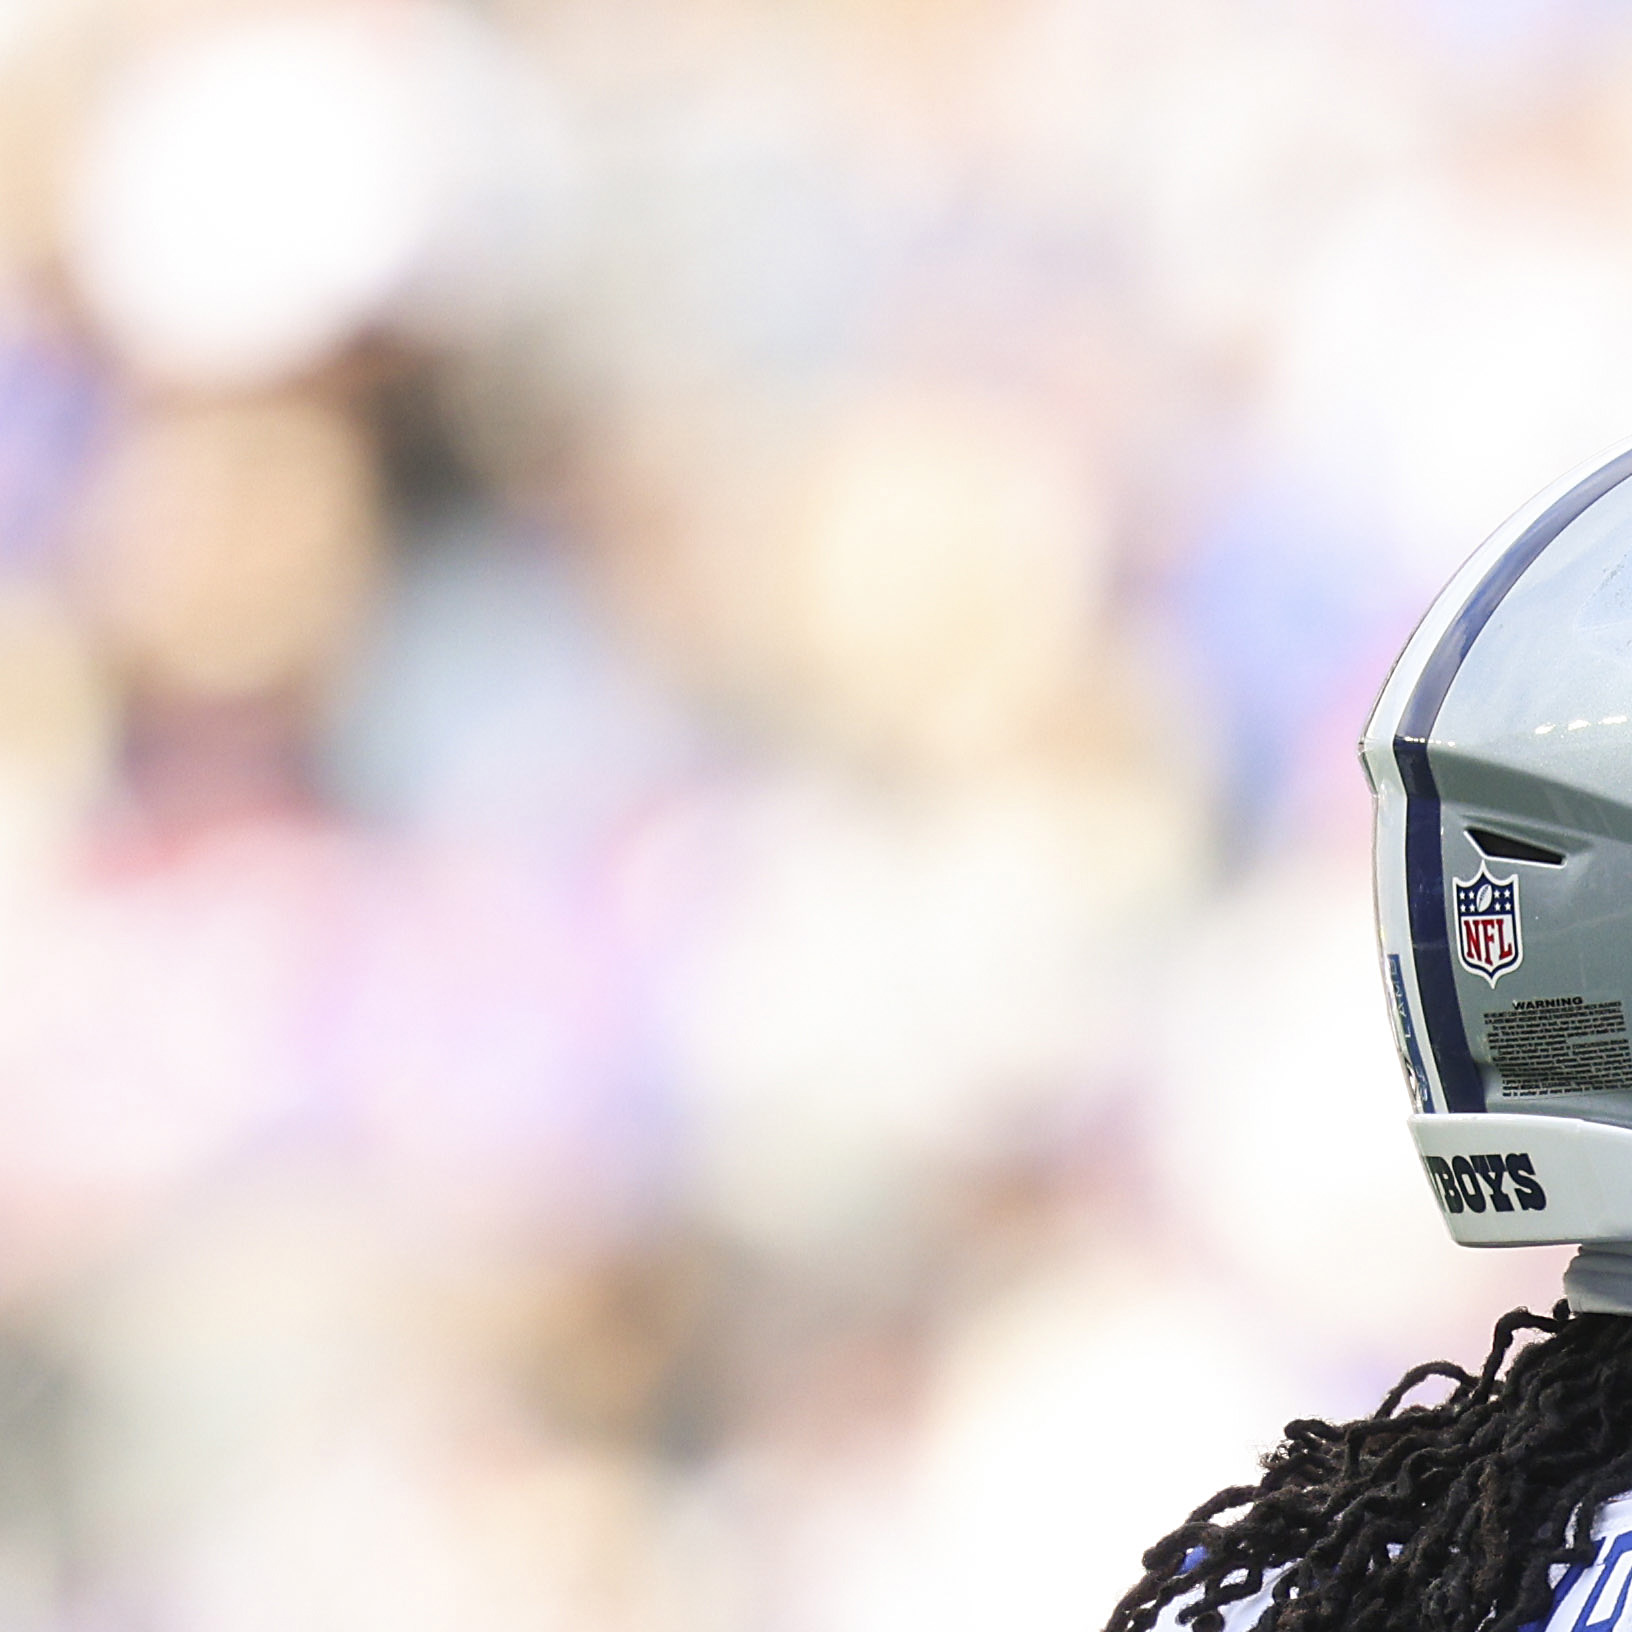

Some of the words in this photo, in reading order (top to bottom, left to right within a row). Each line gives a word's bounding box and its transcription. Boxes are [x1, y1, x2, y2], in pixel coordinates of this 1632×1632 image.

[1463, 918, 1514, 967] NFL
[1513, 996, 1584, 1011] WARNING
[1424, 1152, 1547, 1214] BOYS
